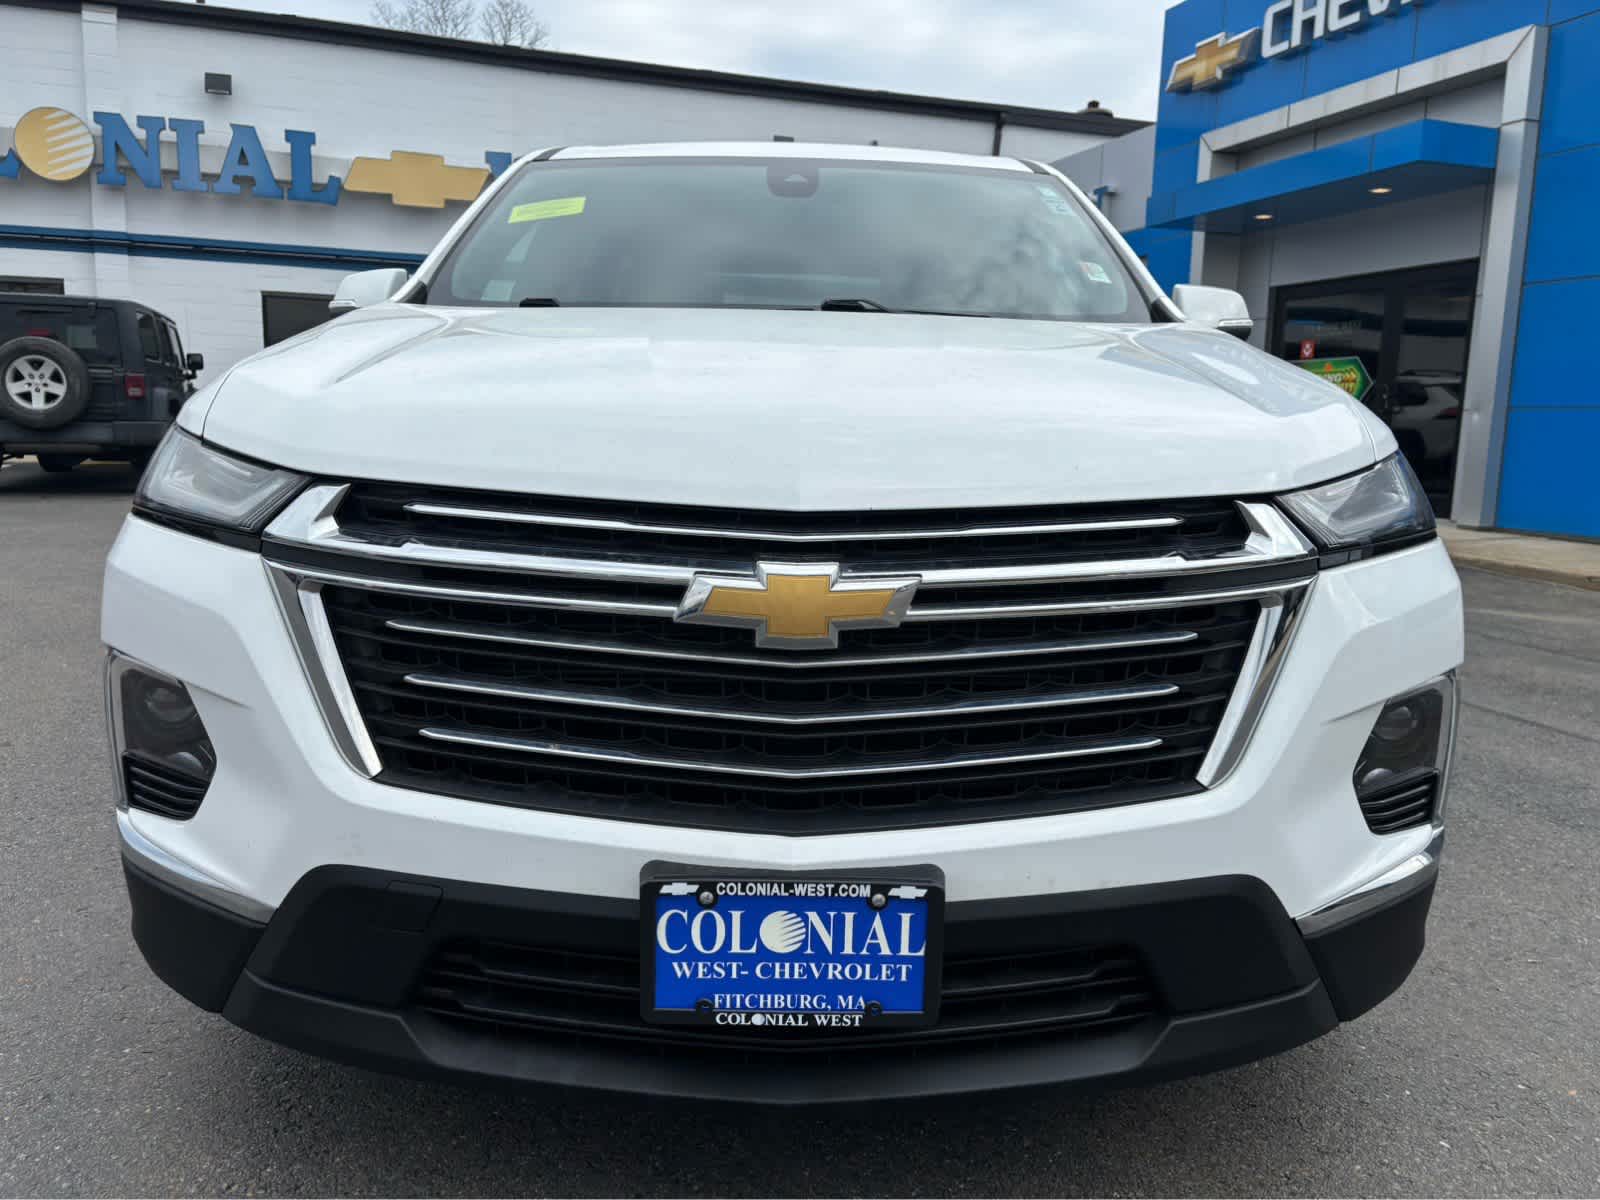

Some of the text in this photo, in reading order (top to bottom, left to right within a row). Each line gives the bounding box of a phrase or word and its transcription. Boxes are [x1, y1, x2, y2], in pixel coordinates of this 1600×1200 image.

[1262, 0, 1412, 58] CHE
[0, 107, 341, 205] ONIAL
[716, 882, 871, 898] COLONIAL-WEST.COM
[656, 909, 926, 957] COLONIAL
[755, 961, 912, 982] CHEVROLET
[713, 993, 866, 1011] FITCHBURG, MA
[715, 1012, 863, 1027] COLONIAL WEST
